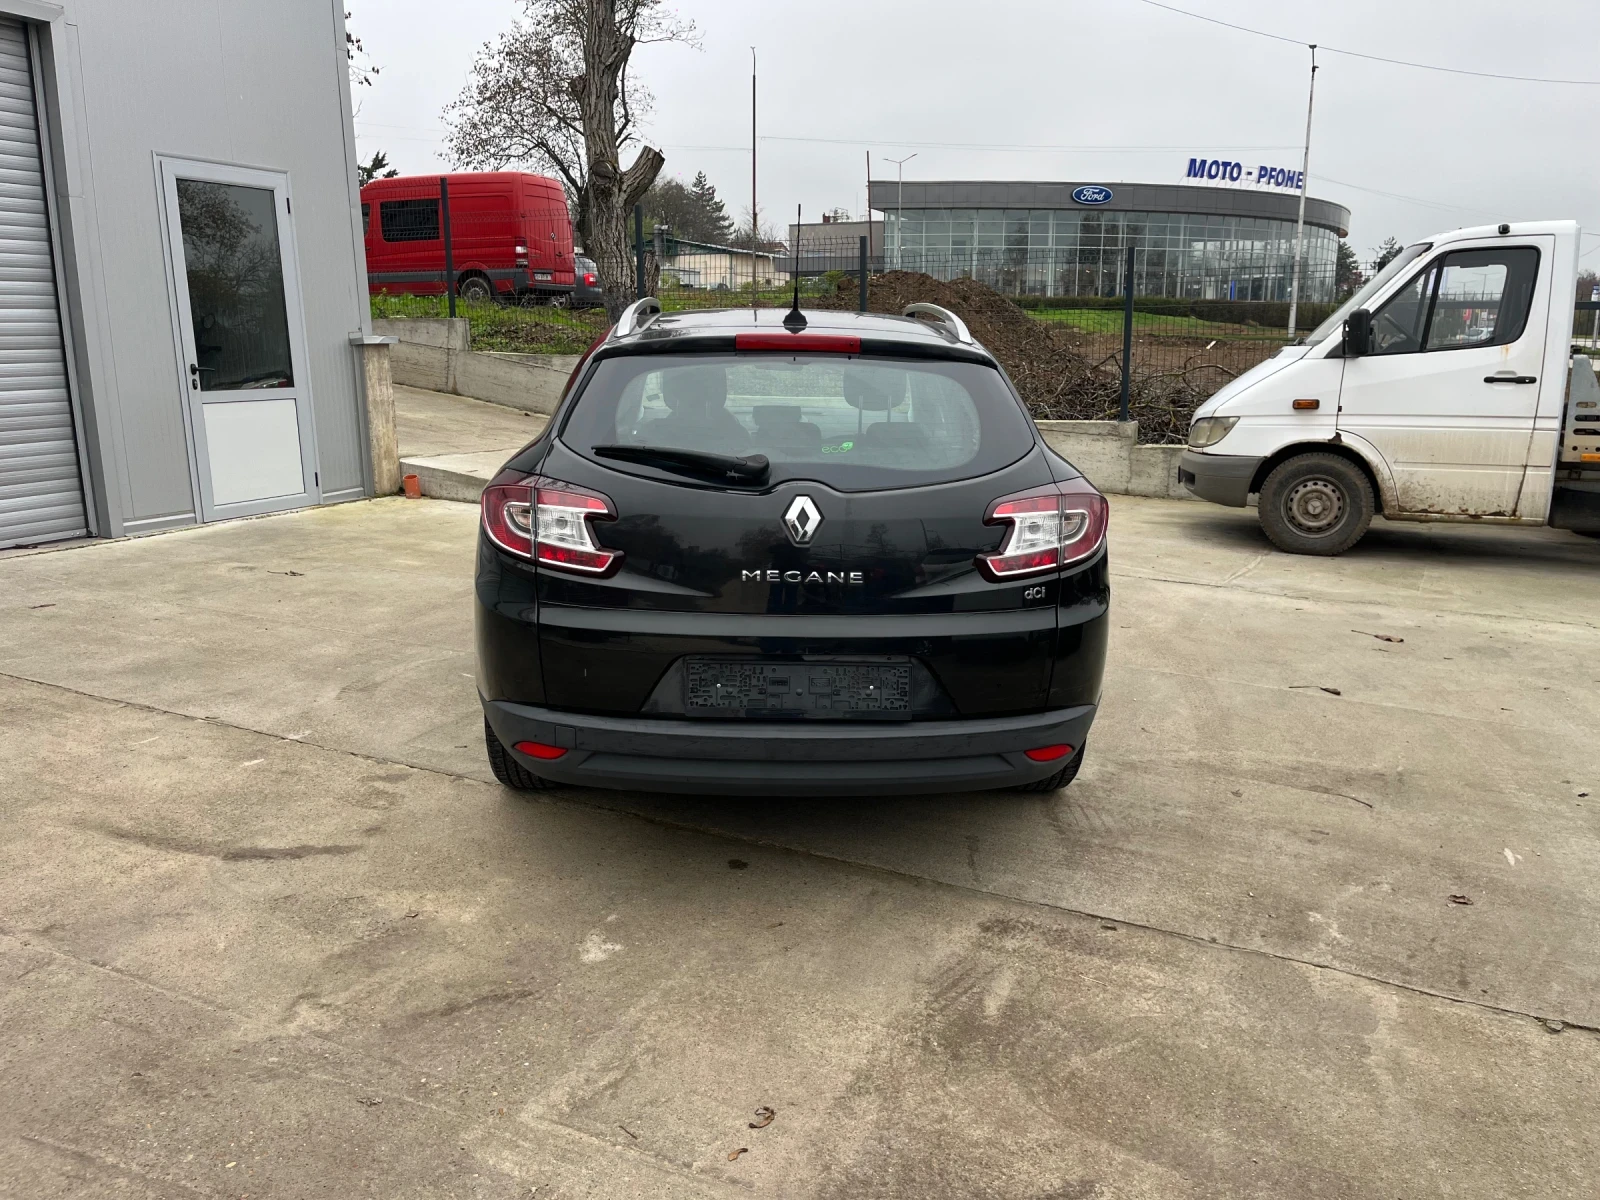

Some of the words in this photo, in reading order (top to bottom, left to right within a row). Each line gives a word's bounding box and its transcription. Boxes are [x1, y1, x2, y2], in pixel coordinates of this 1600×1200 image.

[1186, 158, 1242, 182] MOTO
[1256, 165, 1304, 190] PFOHE
[1080, 188, 1106, 201] Ford
[821, 445, 848, 454] eco
[741, 569, 864, 584] MEGANE
[1024, 586, 1046, 600] dCi
